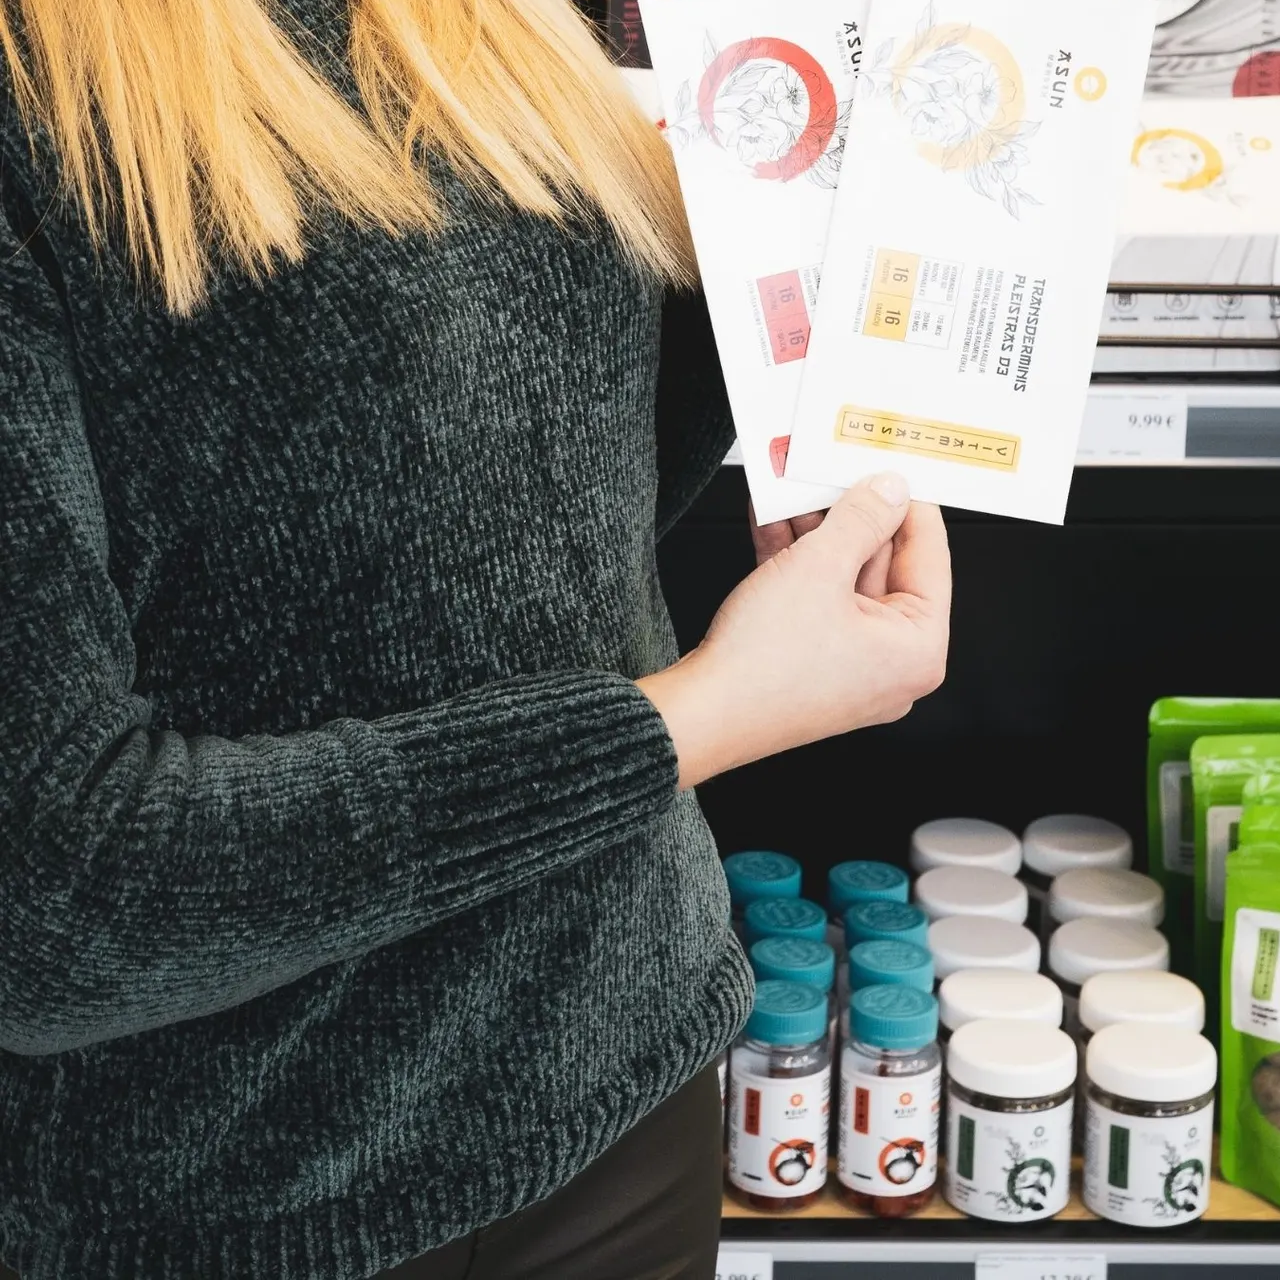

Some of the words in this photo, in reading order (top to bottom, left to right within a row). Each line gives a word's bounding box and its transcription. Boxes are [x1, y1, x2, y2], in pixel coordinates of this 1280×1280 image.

[1049, 49, 1072, 109] ASUN
[892, 267, 910, 283] 16
[778, 285, 796, 304] 16
[884, 309, 902, 326] 16
[1001, 273, 1026, 352] PLEISTRAS
[788, 328, 805, 346] 16
[1014, 278, 1046, 393] TRANSDERMINIS
[996, 357, 1010, 376] D3
[848, 420, 875, 433] D3
[1127, 414, 1162, 427] 9.99
[881, 426, 1008, 457] VITAMINAS
